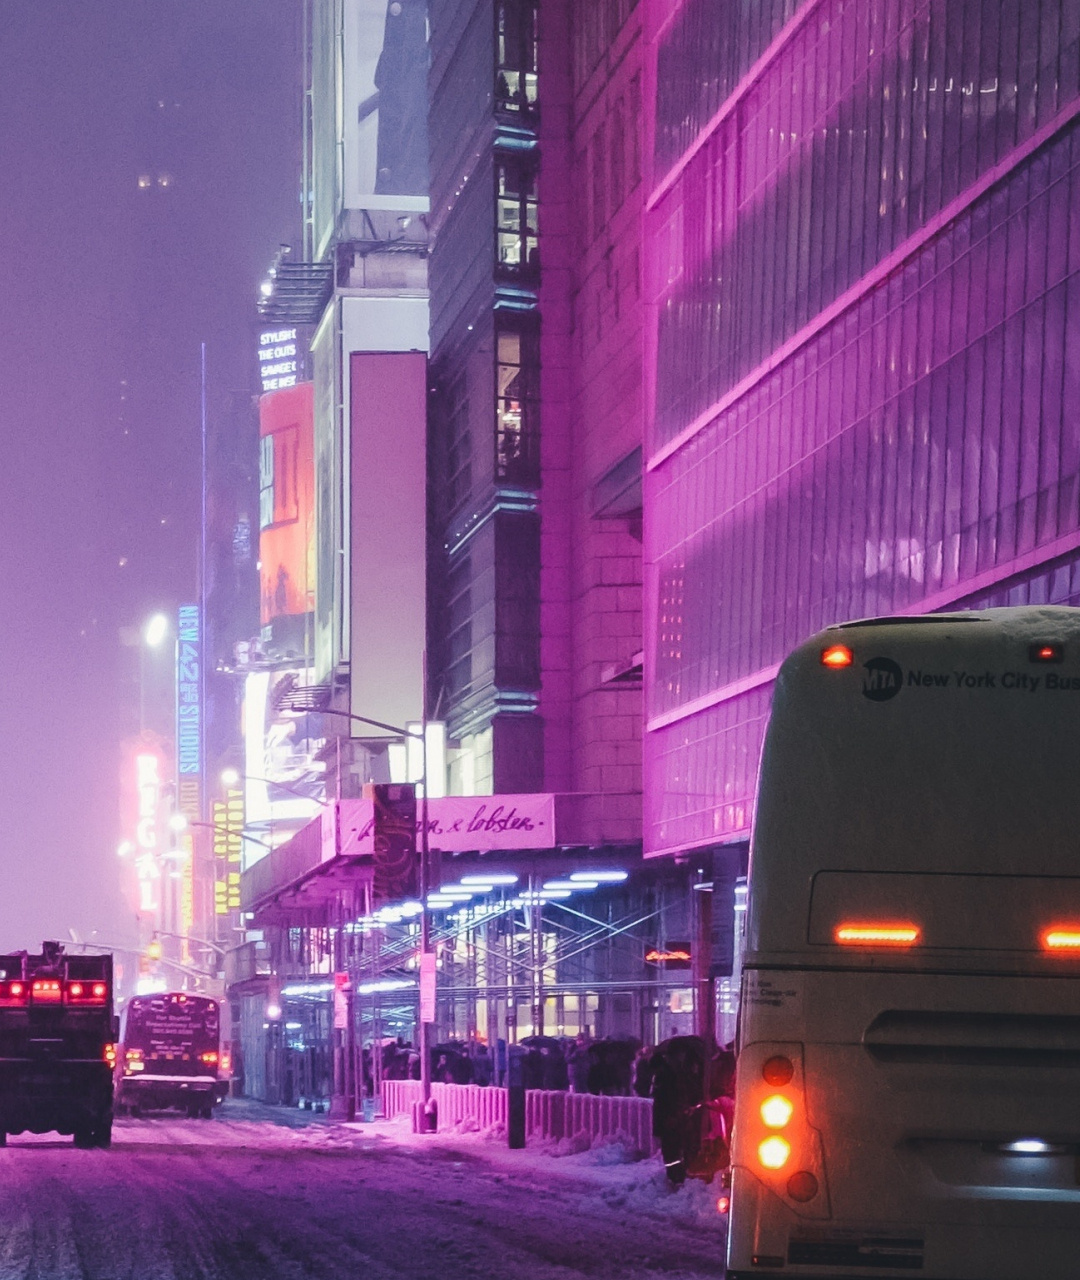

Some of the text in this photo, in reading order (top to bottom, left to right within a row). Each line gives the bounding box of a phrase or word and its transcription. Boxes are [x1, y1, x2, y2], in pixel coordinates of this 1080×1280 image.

[179, 606, 199, 641] NEW
[907, 670, 949, 688] New
[954, 670, 996, 688] York
[1000, 672, 1041, 693] City
[1045, 672, 1080, 691] Bus
[180, 704, 199, 772] STUDIOS
[136, 754, 160, 911] REGAL
[466, 804, 535, 833] lobster
